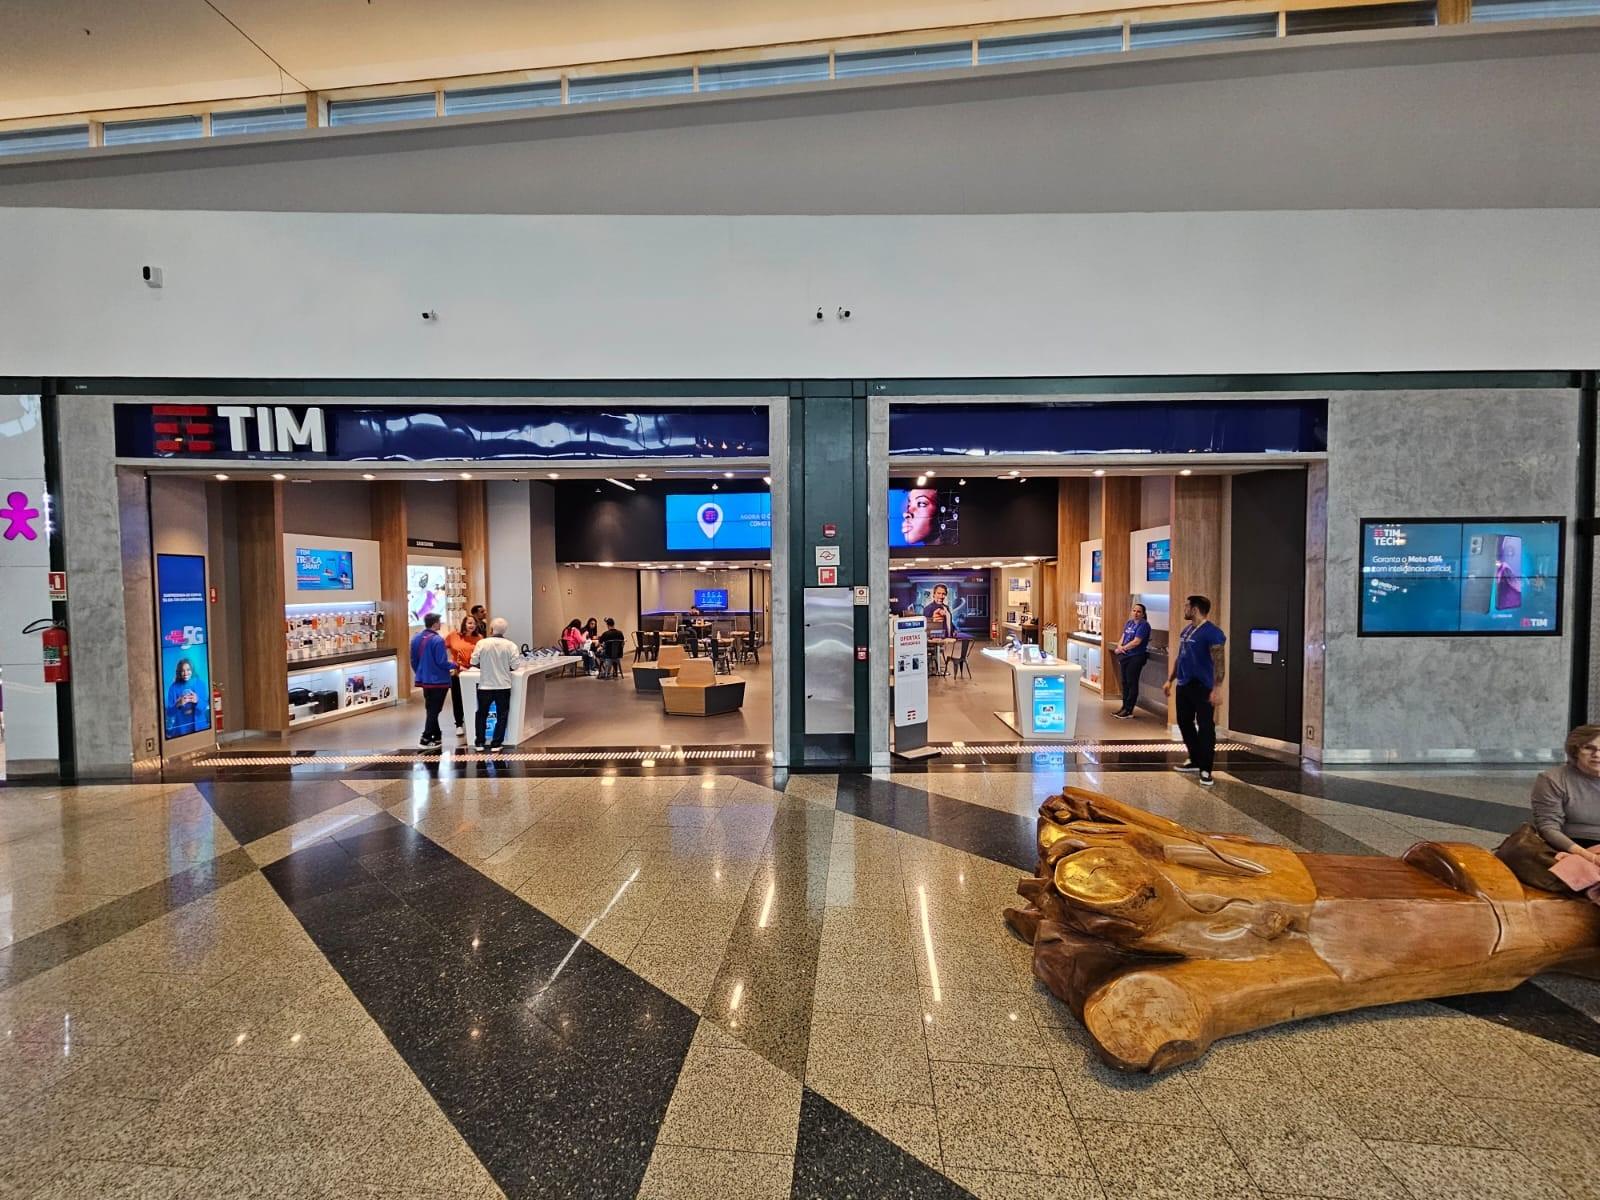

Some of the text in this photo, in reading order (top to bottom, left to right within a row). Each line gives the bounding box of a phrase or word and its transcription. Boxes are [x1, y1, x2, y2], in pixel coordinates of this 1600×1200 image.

[217, 406, 327, 452] TIM
[1383, 529, 1401, 537] TIM
[1372, 555, 1401, 563] Garanta
[1408, 555, 1427, 563] Moto
[1529, 618, 1548, 627] TIM
